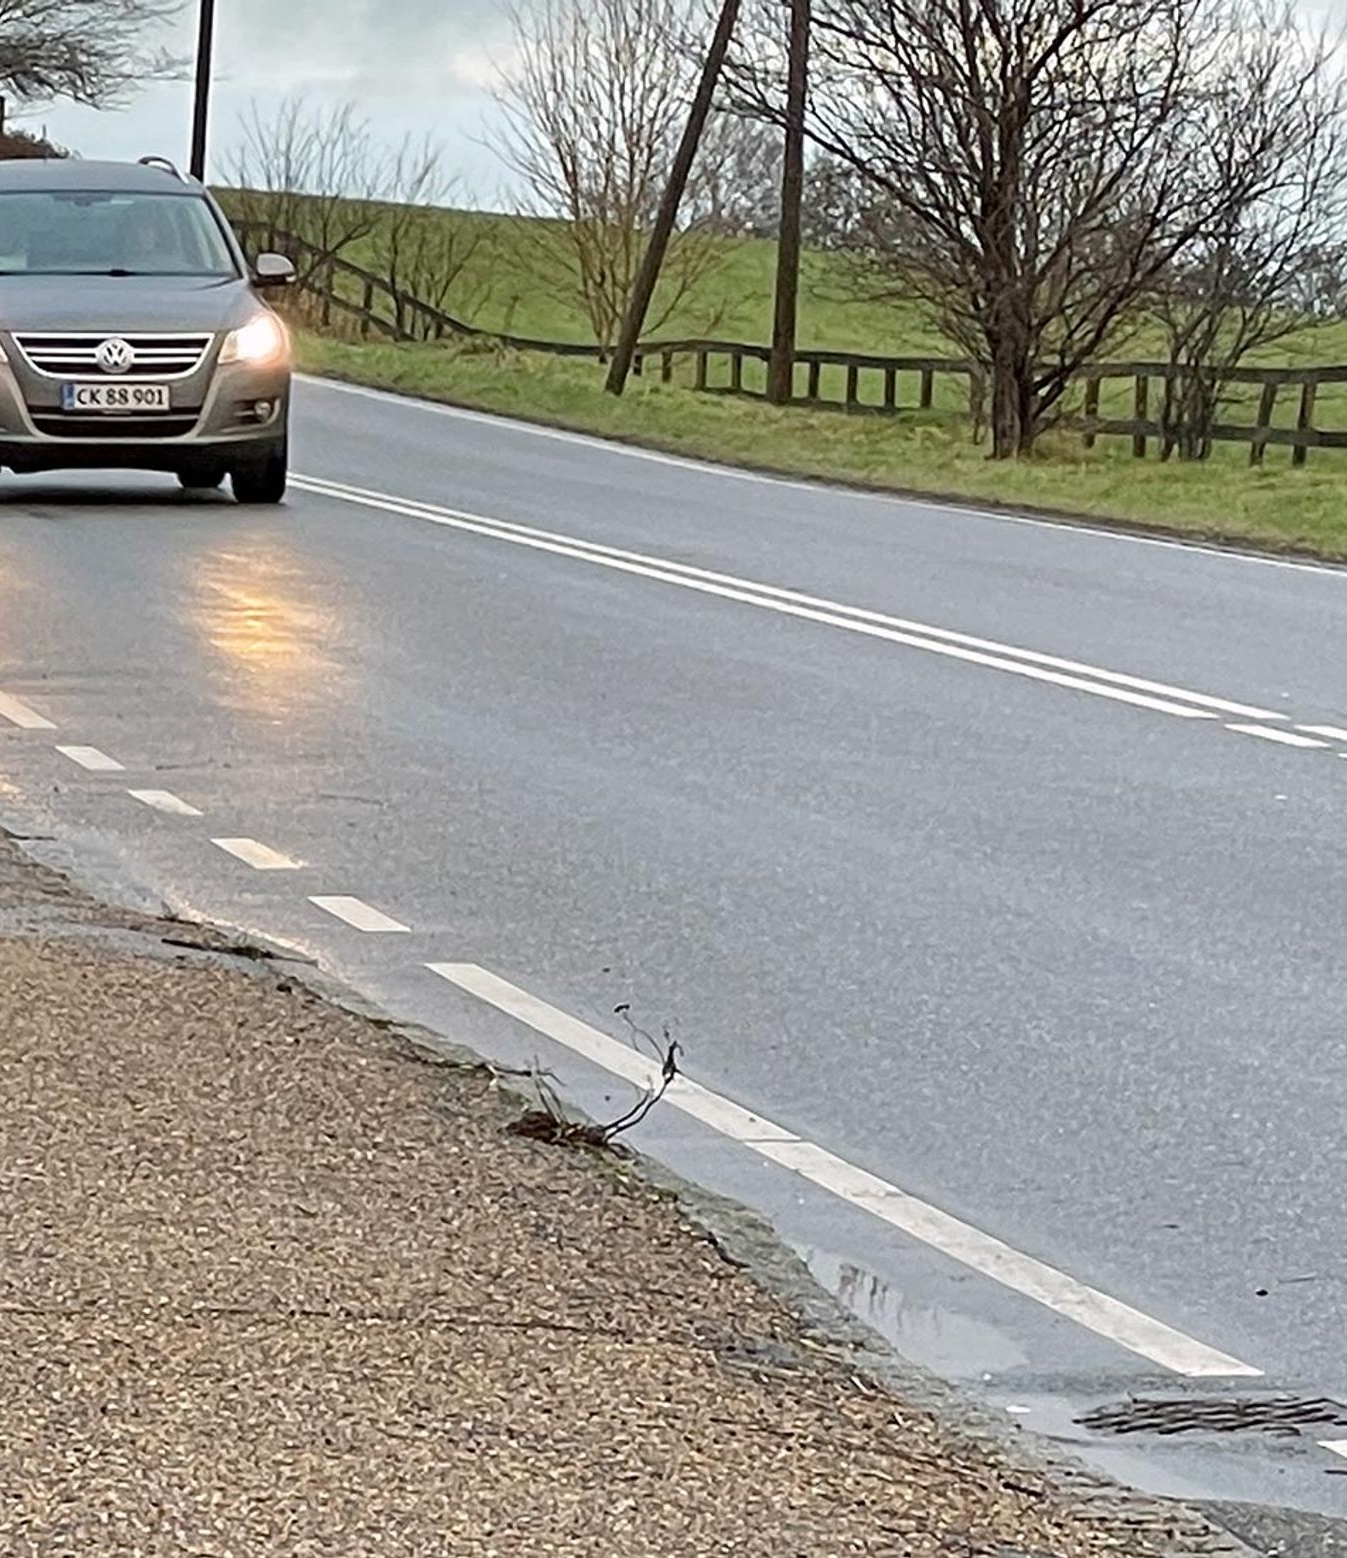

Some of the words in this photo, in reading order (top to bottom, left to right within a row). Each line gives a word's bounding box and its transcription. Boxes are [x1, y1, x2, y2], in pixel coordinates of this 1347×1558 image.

[77, 388, 101, 405] CK
[106, 388, 129, 405] 88
[133, 388, 164, 405] 901
